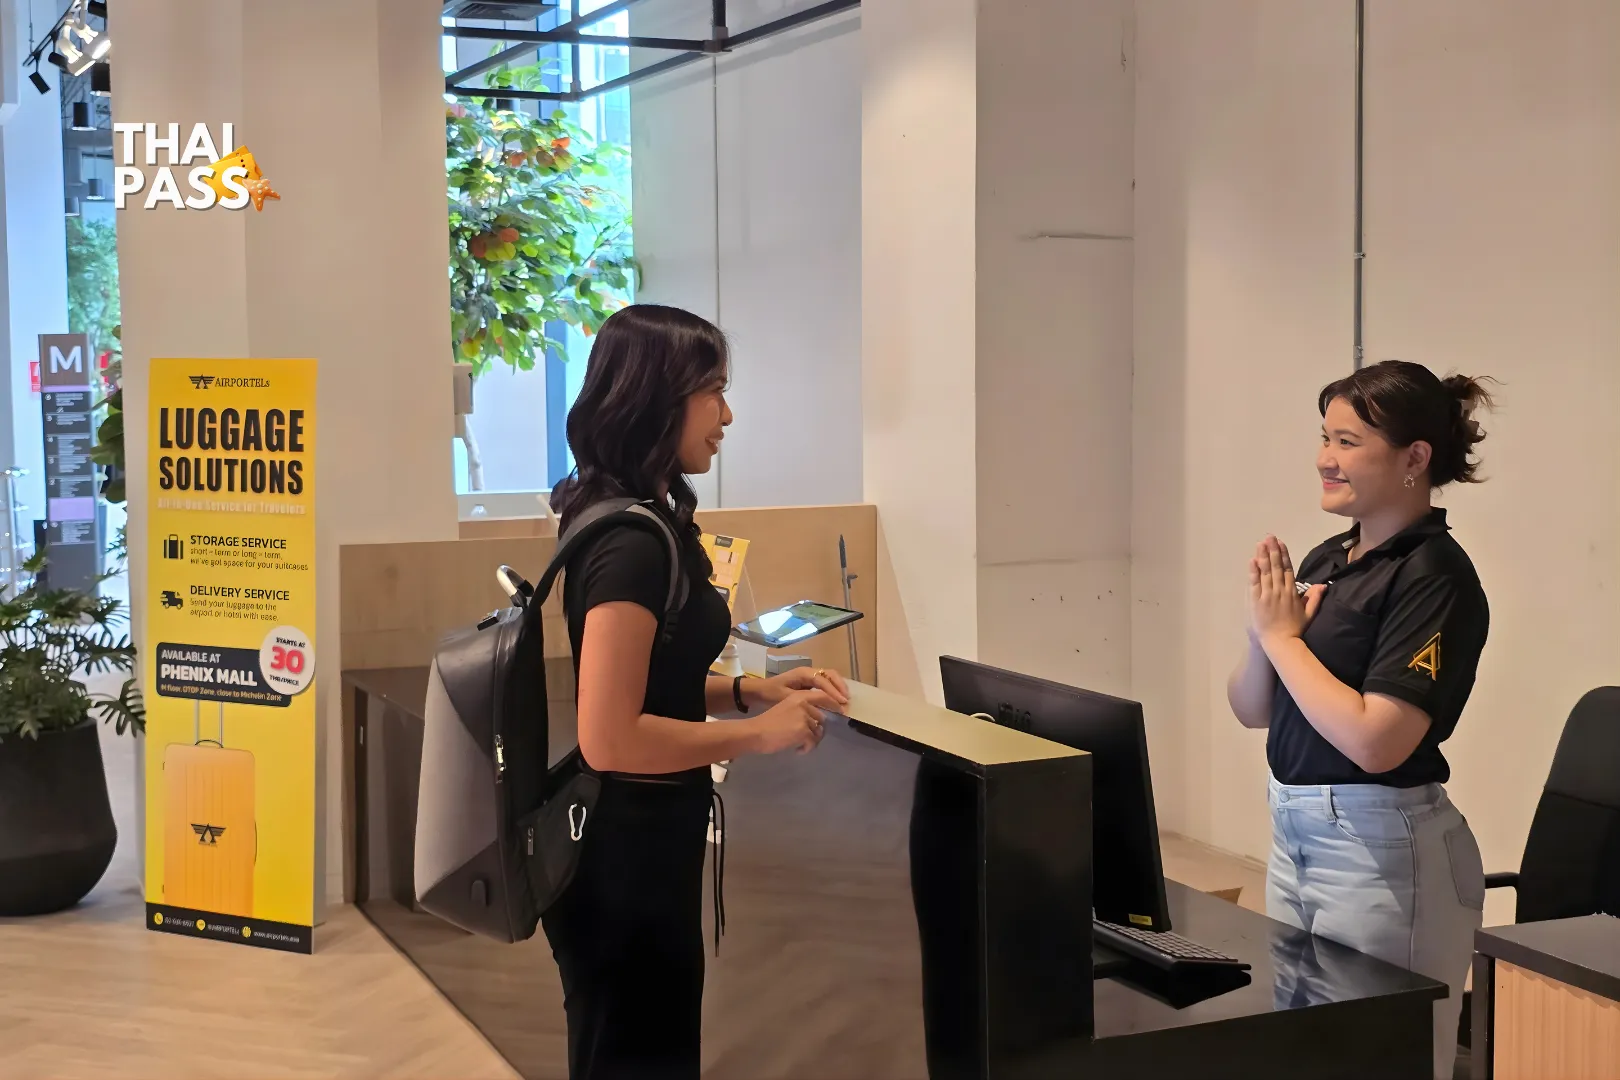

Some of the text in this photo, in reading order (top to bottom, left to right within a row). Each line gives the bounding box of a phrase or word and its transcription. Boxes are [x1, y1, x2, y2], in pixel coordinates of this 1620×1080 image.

[50, 345, 82, 374] M
[160, 408, 304, 452] LUGGAGE
[160, 456, 303, 494] SOLUTIONS
[190, 535, 286, 549] STORAGE SERVICE
[242, 550, 257, 559] long
[190, 585, 290, 600] DELIVERY SERVICE
[162, 649, 221, 663] AVAILABLE AT
[271, 646, 305, 674] 30
[161, 664, 257, 686] PHENIX MALL
